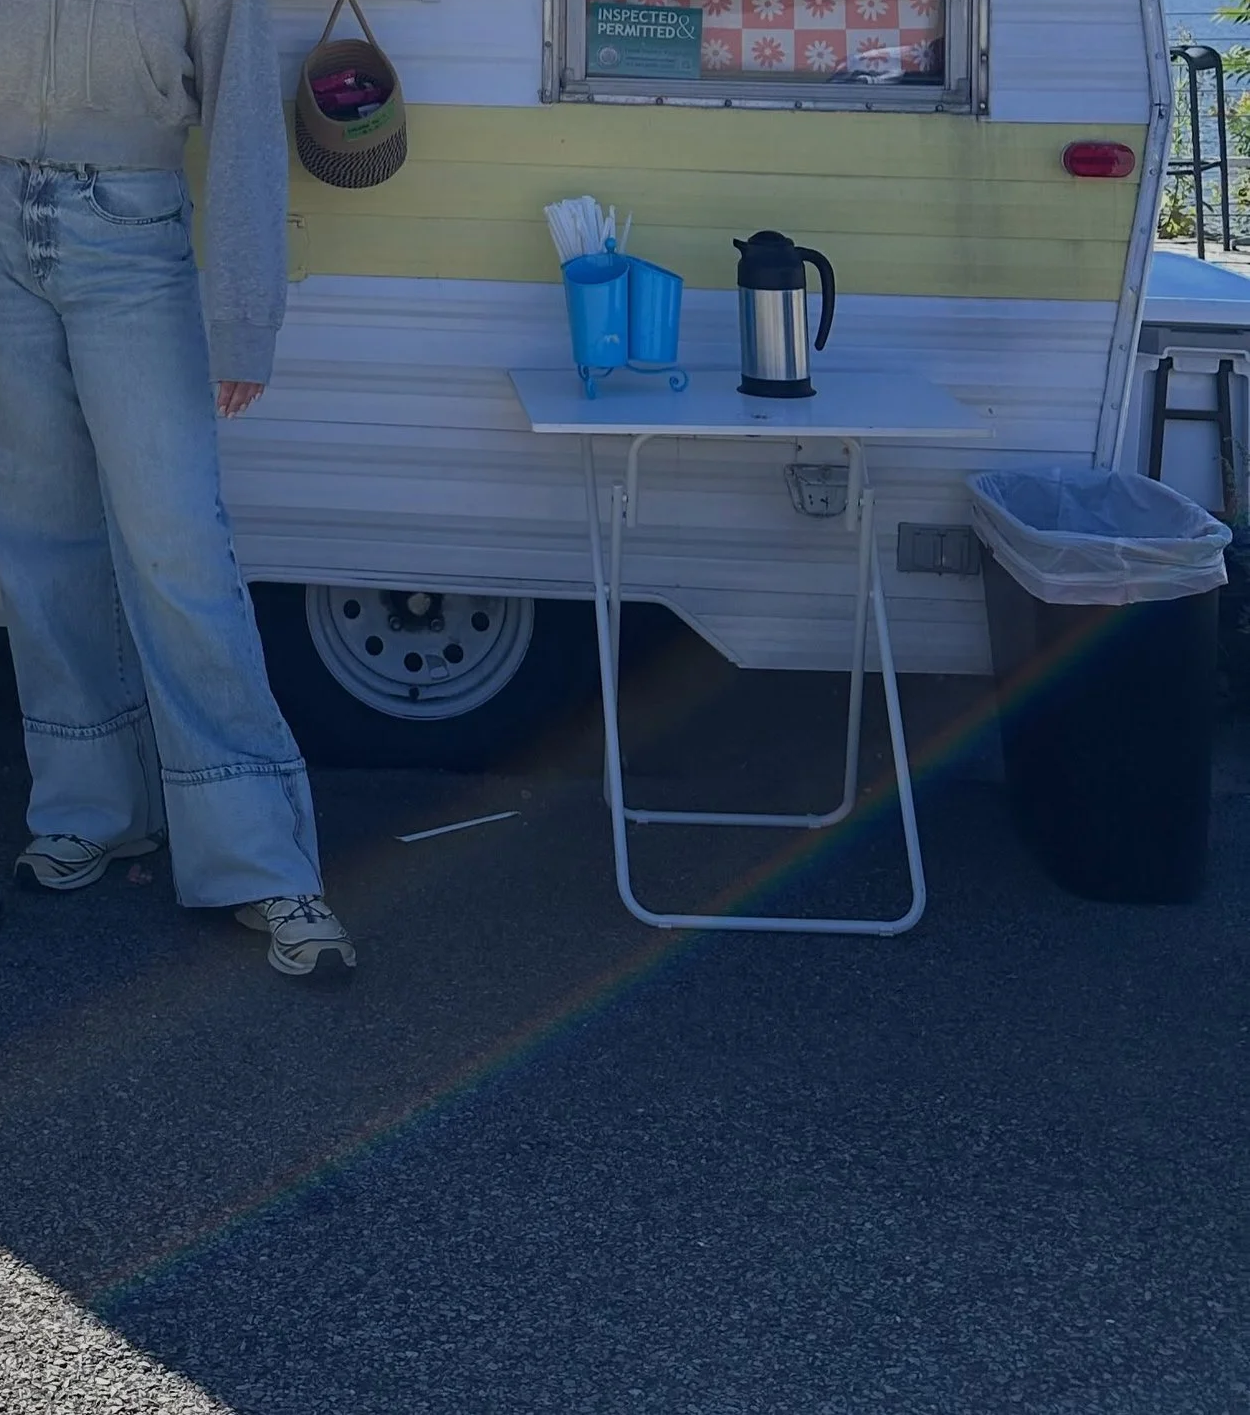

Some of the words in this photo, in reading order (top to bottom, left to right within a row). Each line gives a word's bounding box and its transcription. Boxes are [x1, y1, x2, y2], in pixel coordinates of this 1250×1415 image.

[597, 8, 678, 24] INSPECTED
[676, 15, 695, 39] &
[597, 23, 676, 39] PERMITTED
